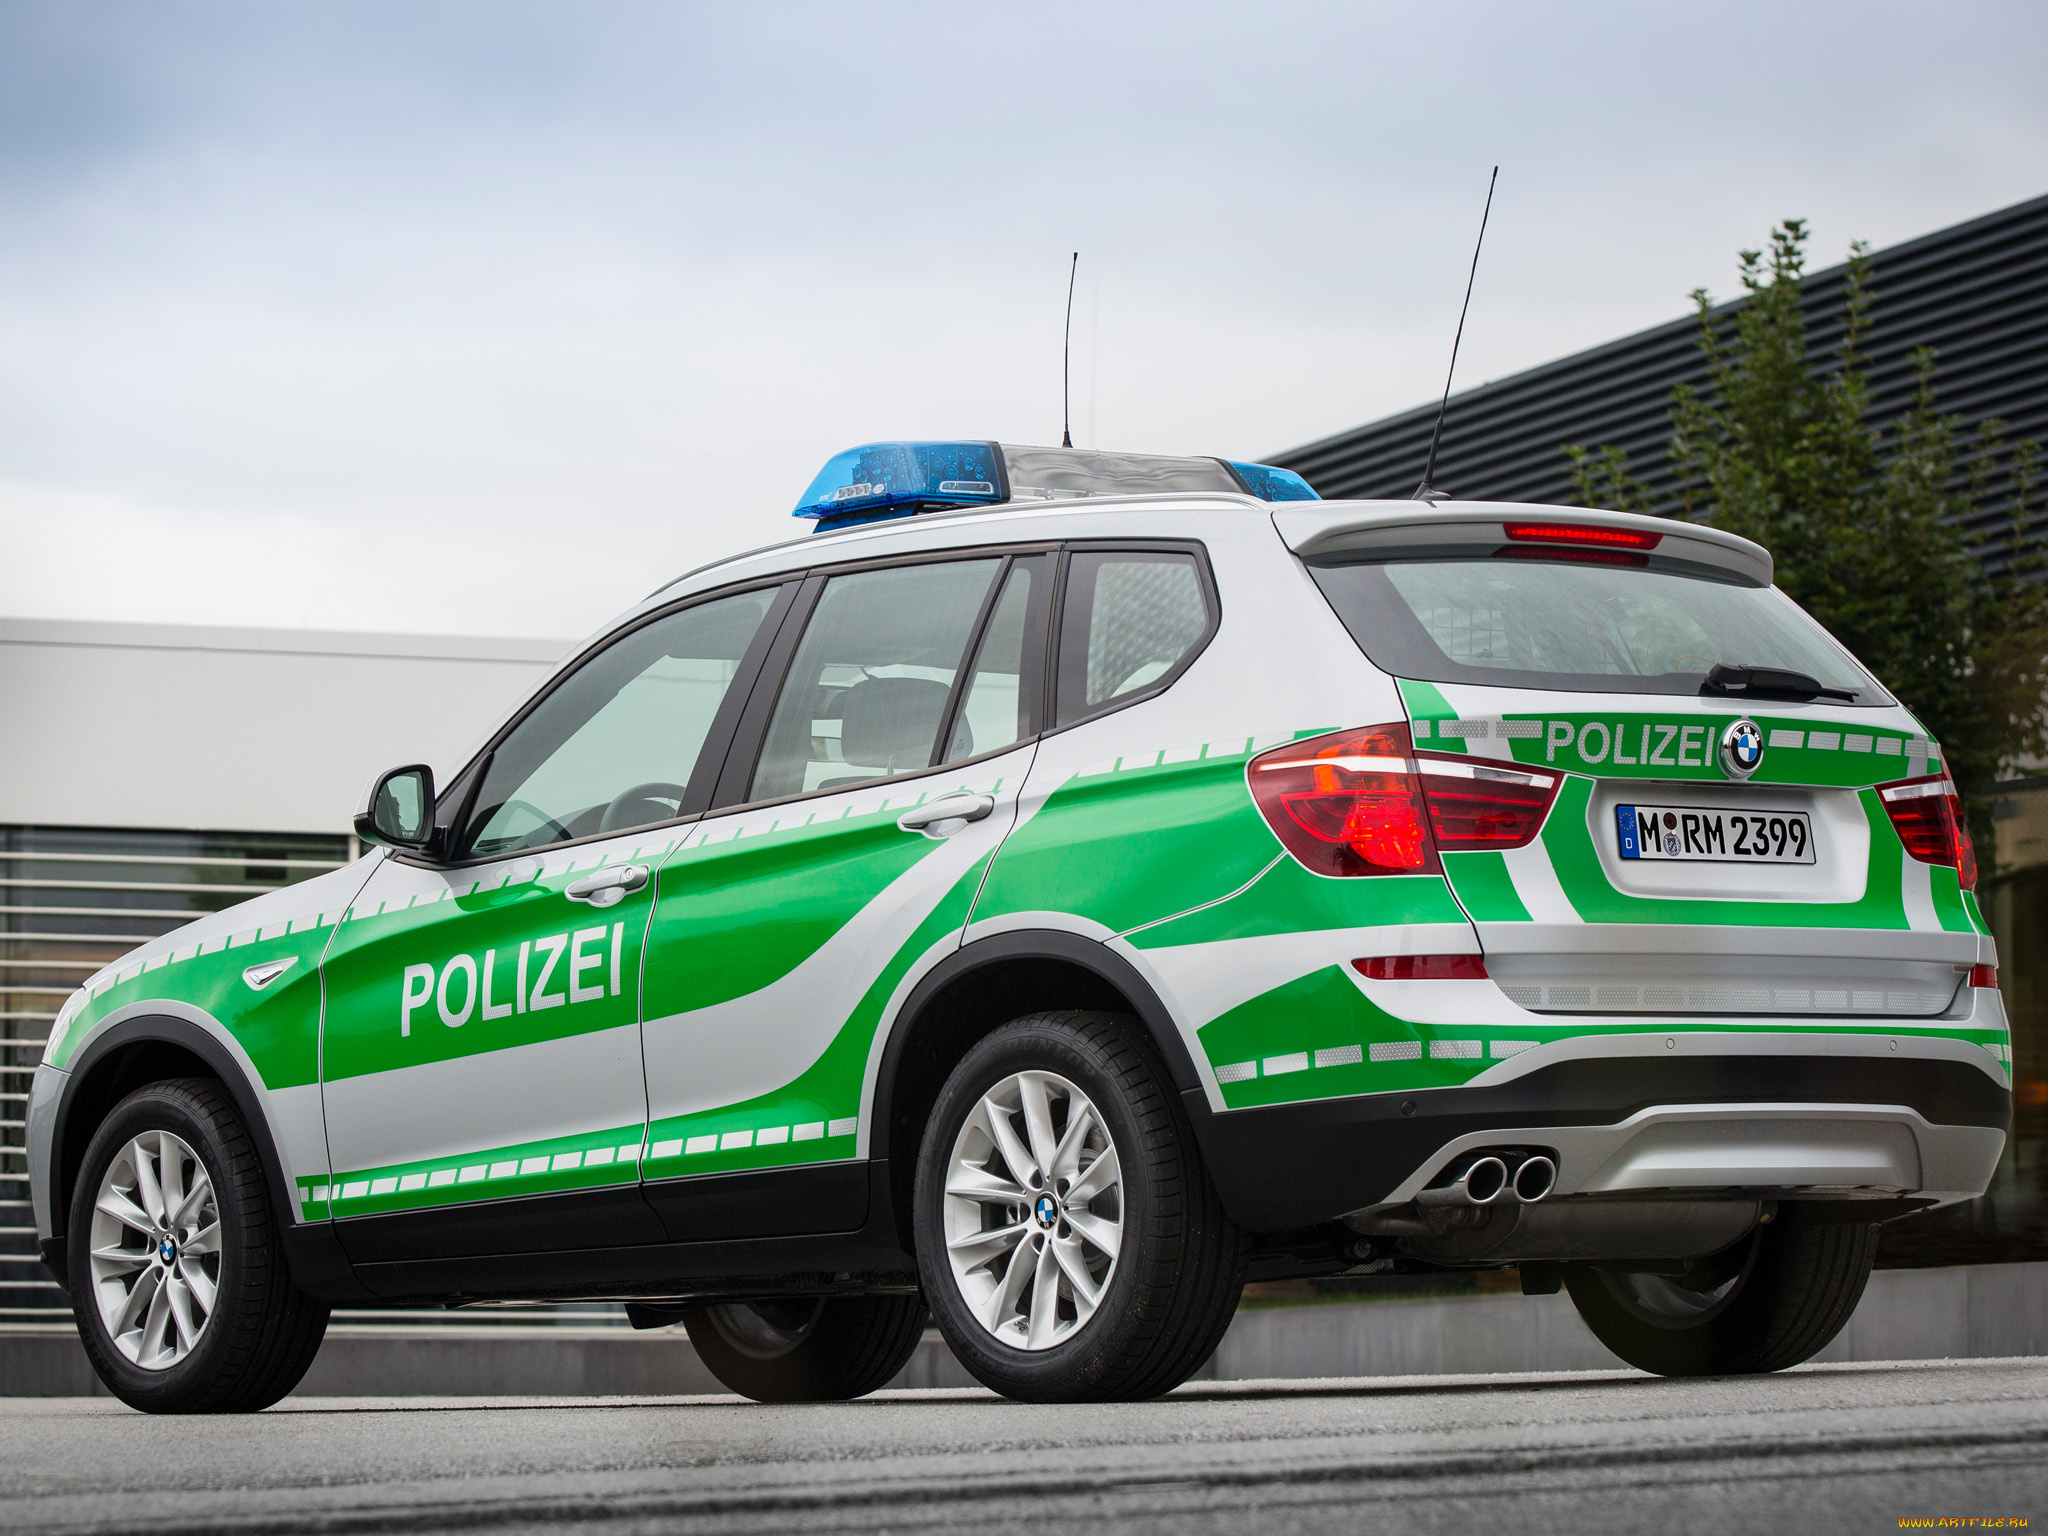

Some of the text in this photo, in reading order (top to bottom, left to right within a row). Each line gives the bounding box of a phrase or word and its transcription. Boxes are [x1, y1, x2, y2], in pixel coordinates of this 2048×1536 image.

[1546, 720, 1716, 767] POLIZEI
[1733, 726, 1760, 742] BMW
[1625, 837, 1633, 849] D
[1637, 812, 1807, 857] M RM 2399
[401, 921, 625, 1038] POLIZEI
